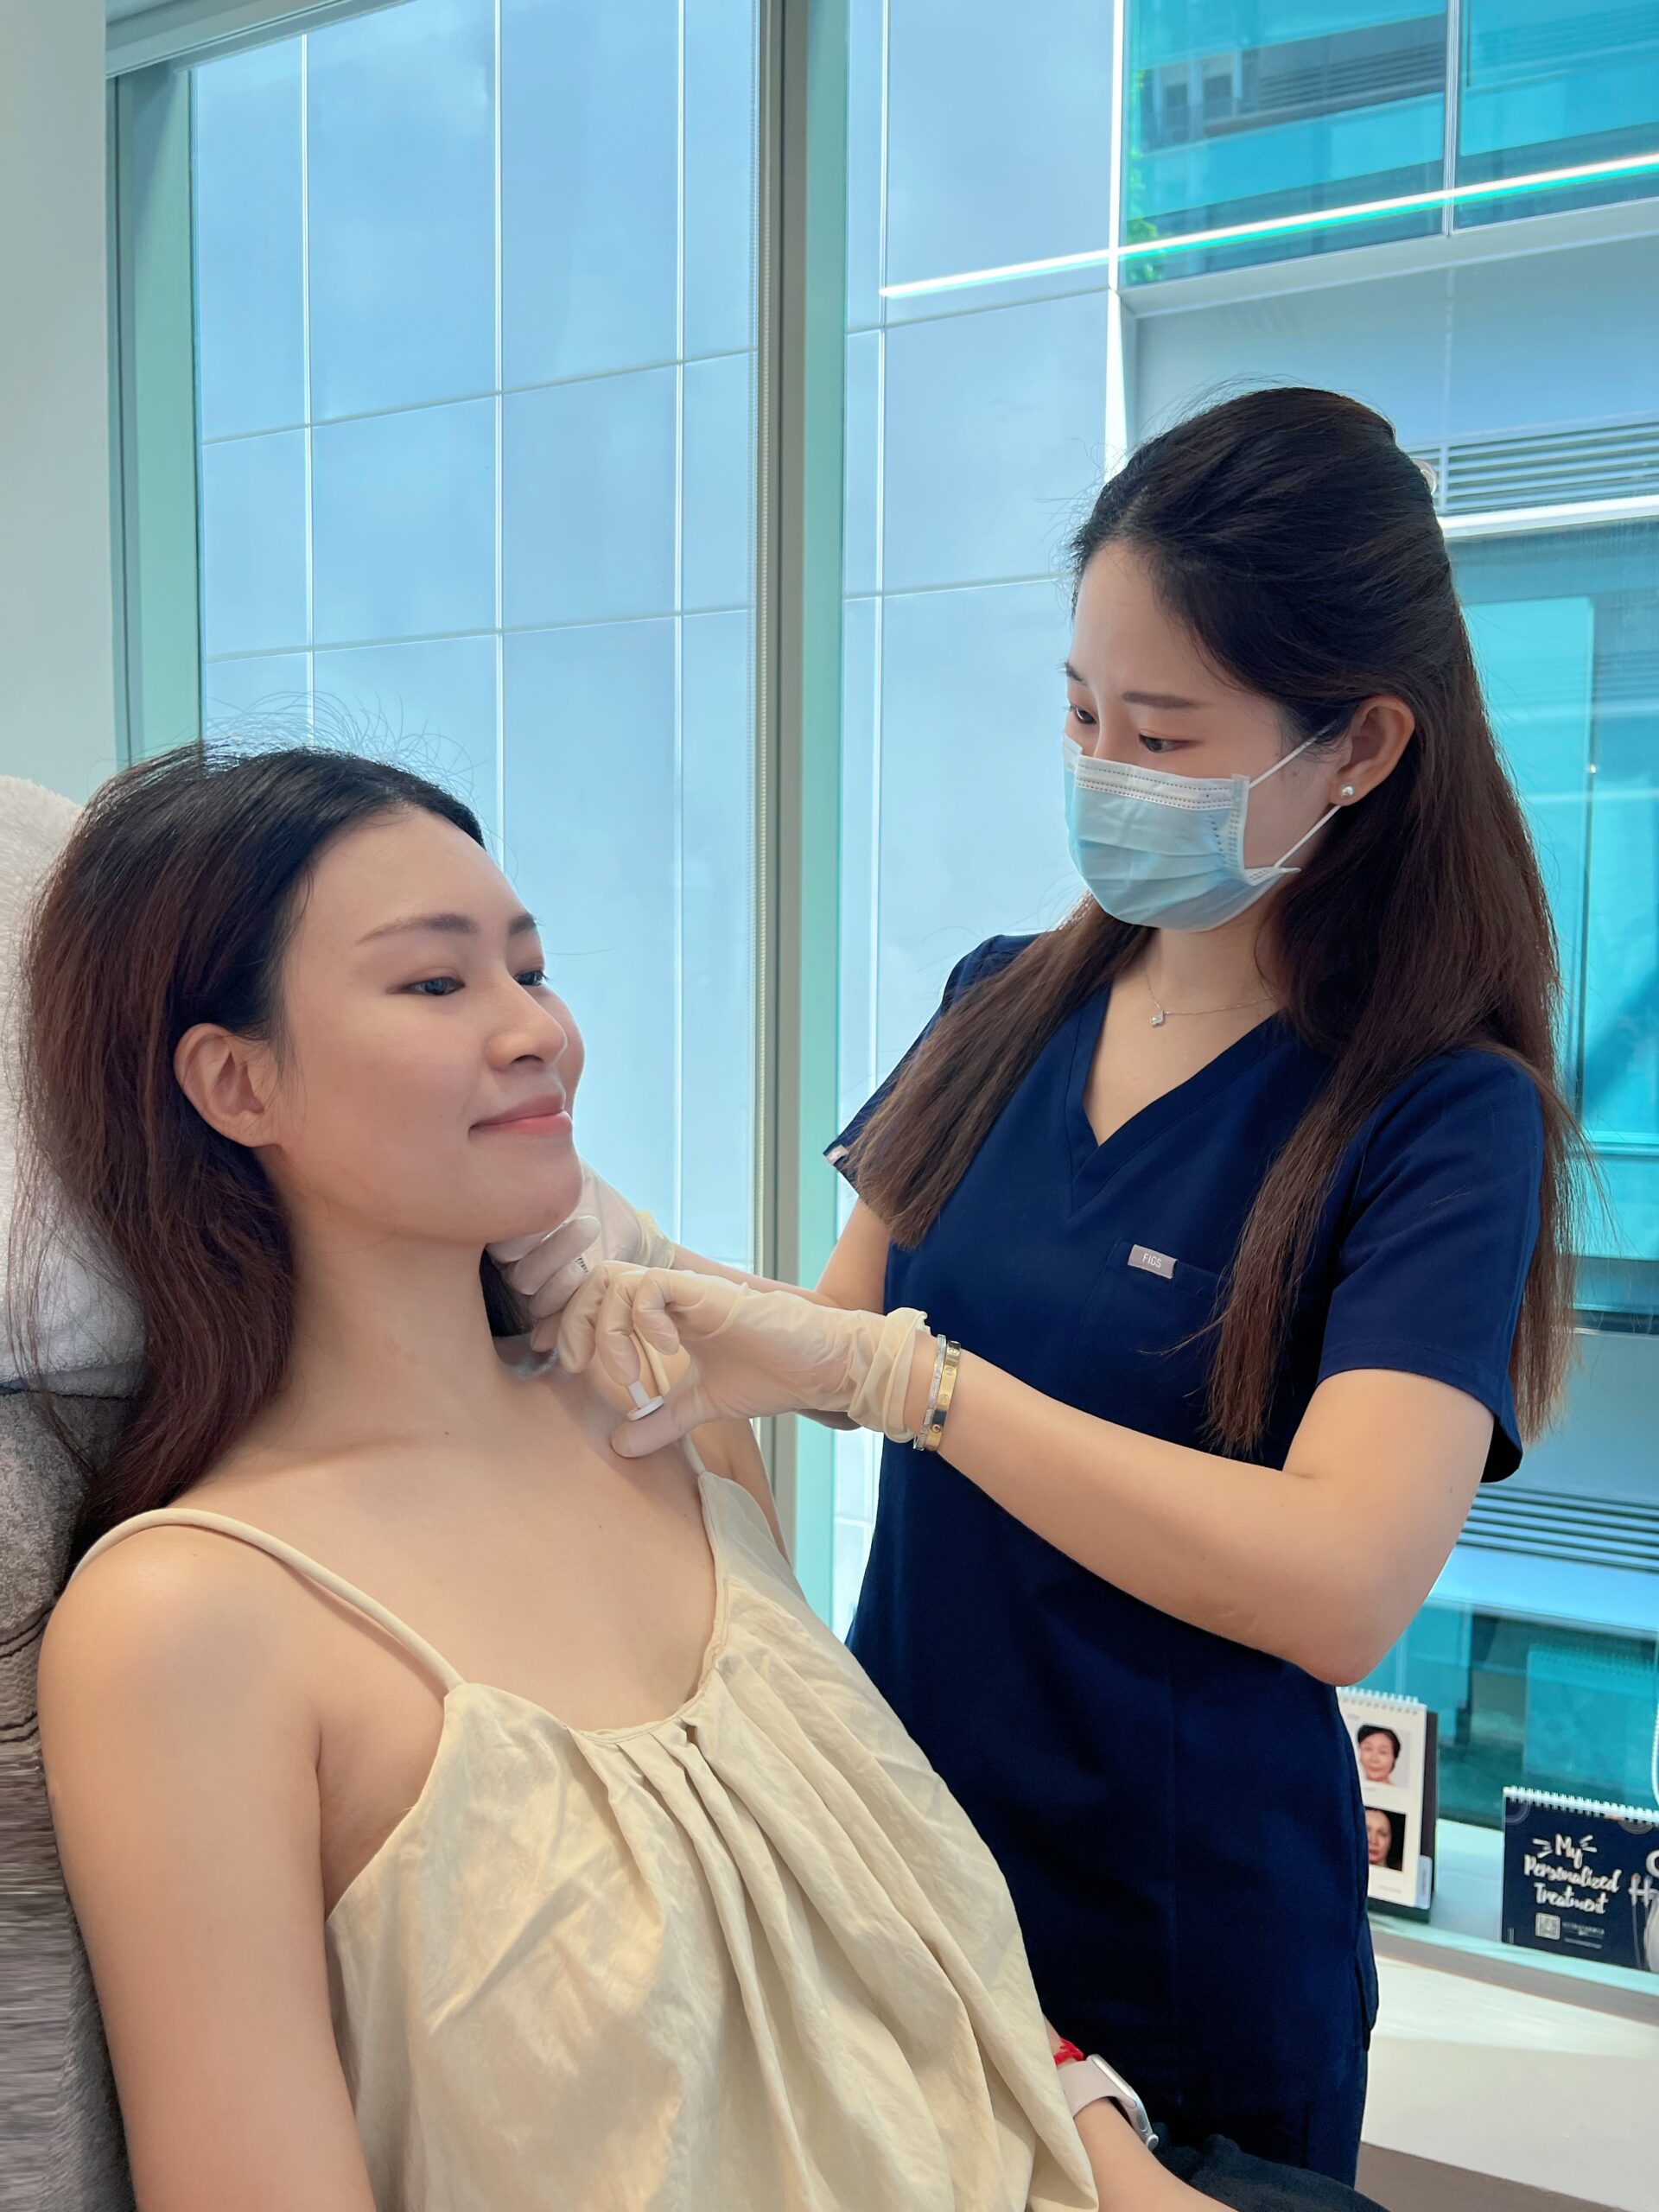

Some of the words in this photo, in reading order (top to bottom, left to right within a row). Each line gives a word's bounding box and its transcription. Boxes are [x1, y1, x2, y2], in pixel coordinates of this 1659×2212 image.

[1141, 1252, 1162, 1268] FIGS
[1555, 1834, 1583, 1868] My
[1534, 1882, 1608, 1914] Treatment
